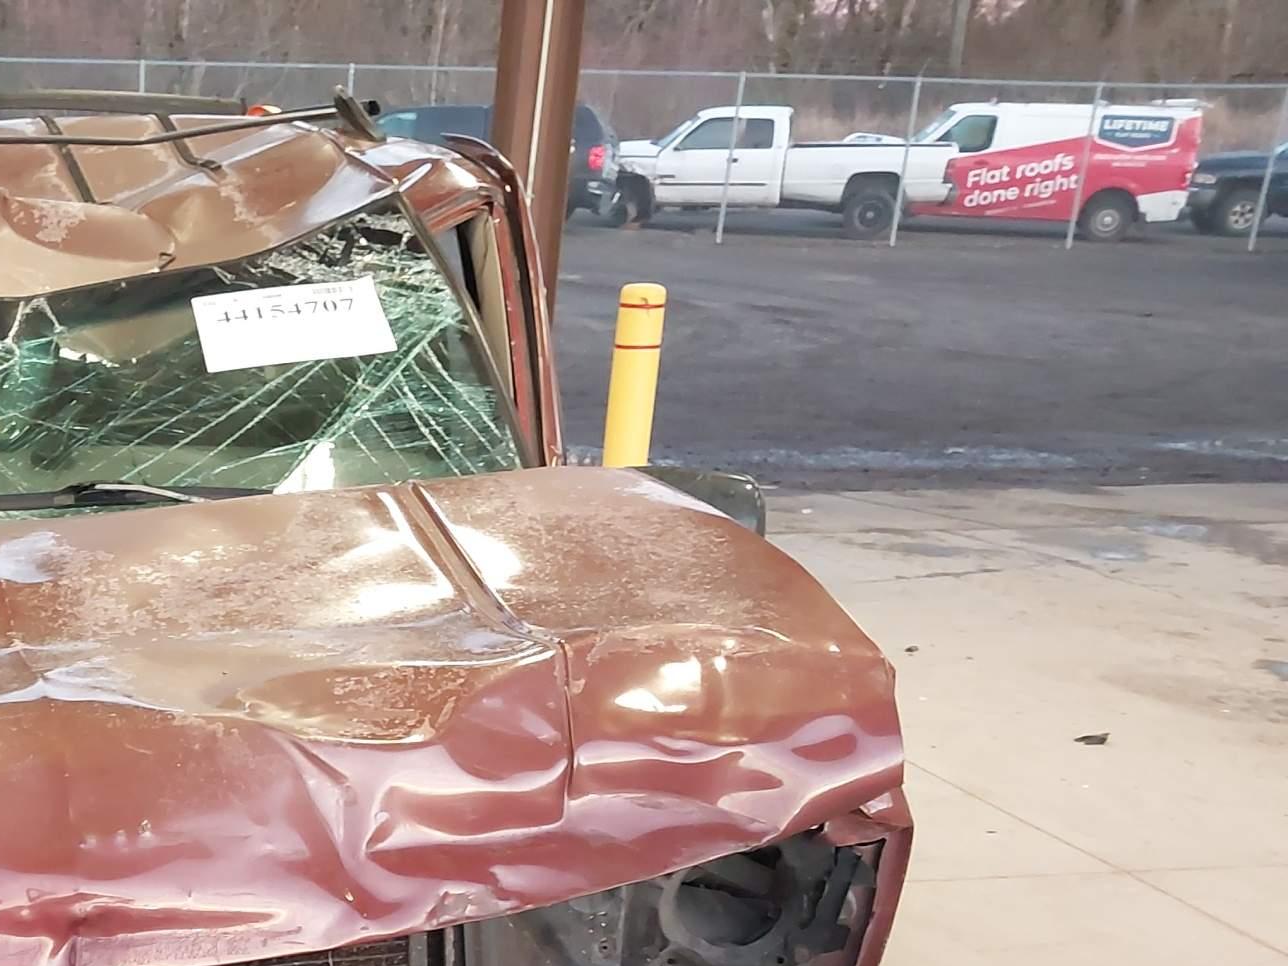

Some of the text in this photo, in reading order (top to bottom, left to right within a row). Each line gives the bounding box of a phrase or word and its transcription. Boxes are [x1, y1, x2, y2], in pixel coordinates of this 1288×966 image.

[1103, 119, 1170, 132] LIFETIME
[967, 152, 1074, 188] Flat roofs
[964, 187, 1019, 207] done
[1024, 174, 1079, 198] right
[217, 298, 353, 323] 44154707
